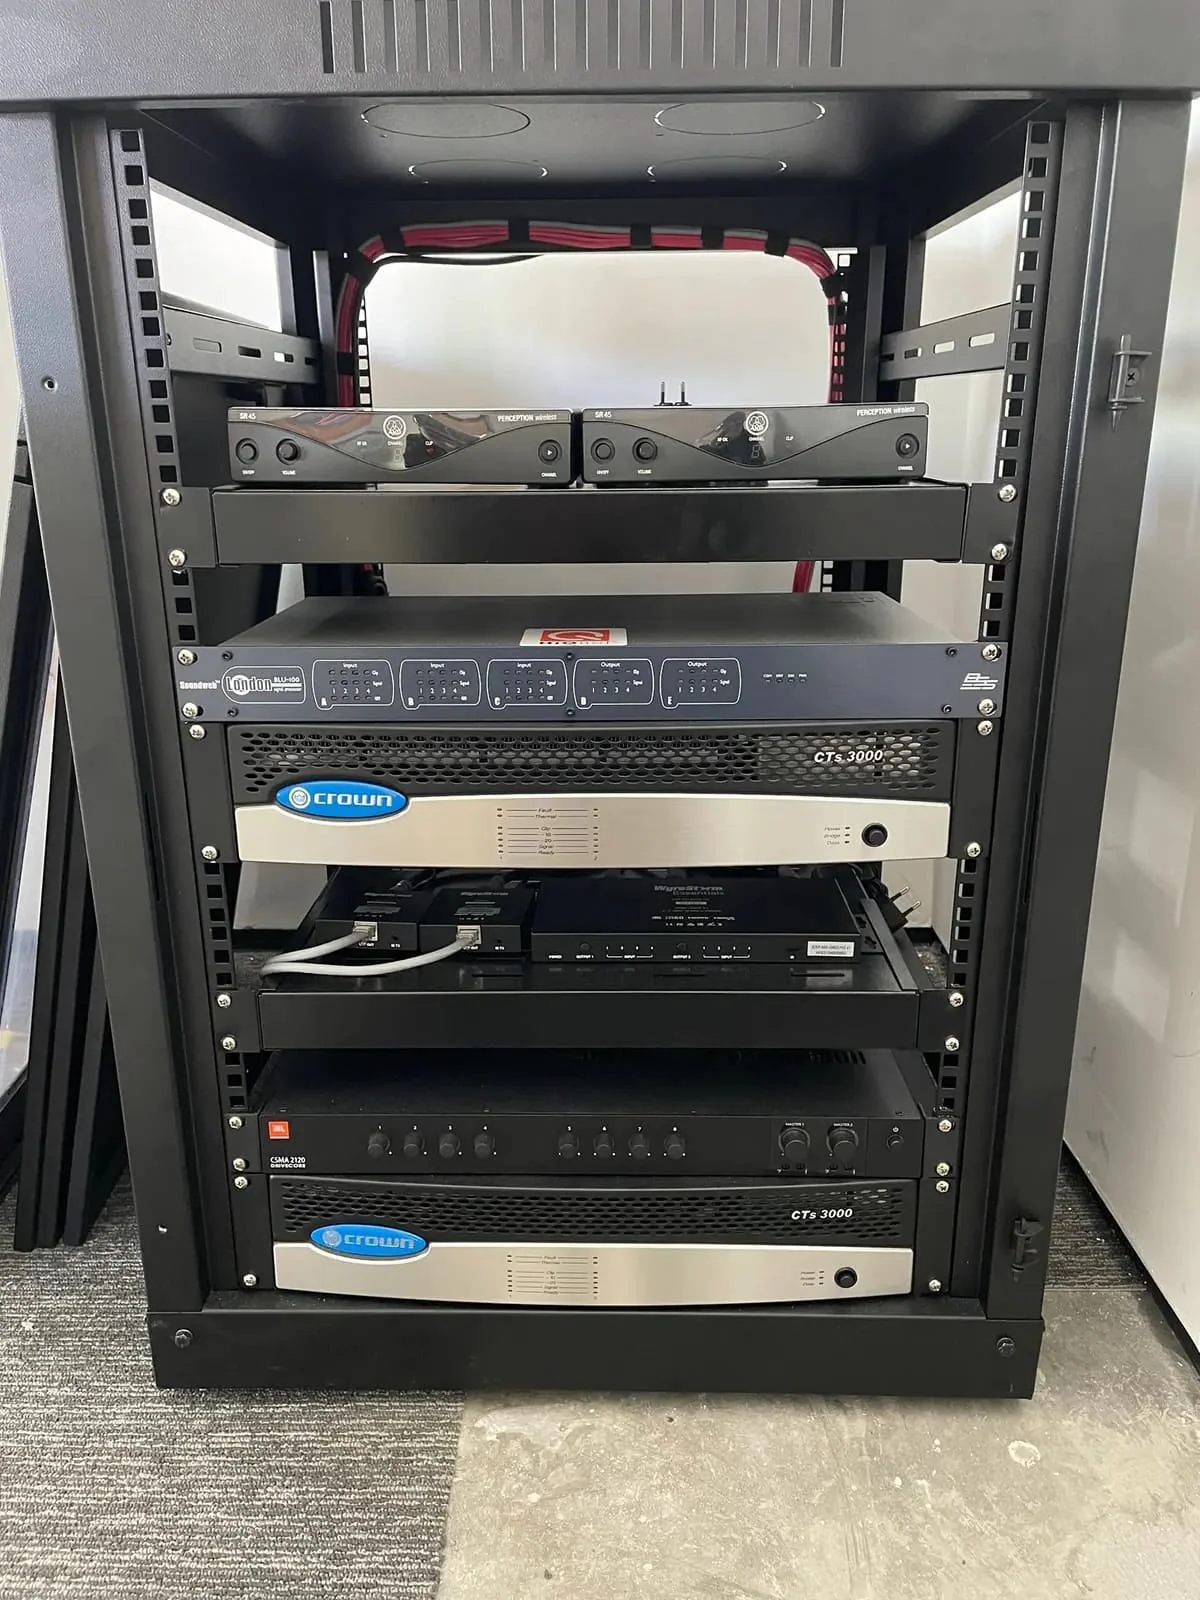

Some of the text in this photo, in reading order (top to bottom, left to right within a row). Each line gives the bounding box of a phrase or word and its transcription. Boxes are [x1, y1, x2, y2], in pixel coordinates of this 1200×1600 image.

[497, 413, 557, 422] PERCEPTION wireless
[856, 407, 892, 416] PERCEPTION
[225, 675, 273, 694] London
[814, 750, 884, 763] CTs 3000
[314, 792, 393, 807] crown
[791, 1208, 853, 1220] CTs 3000
[344, 1234, 414, 1249] crown
